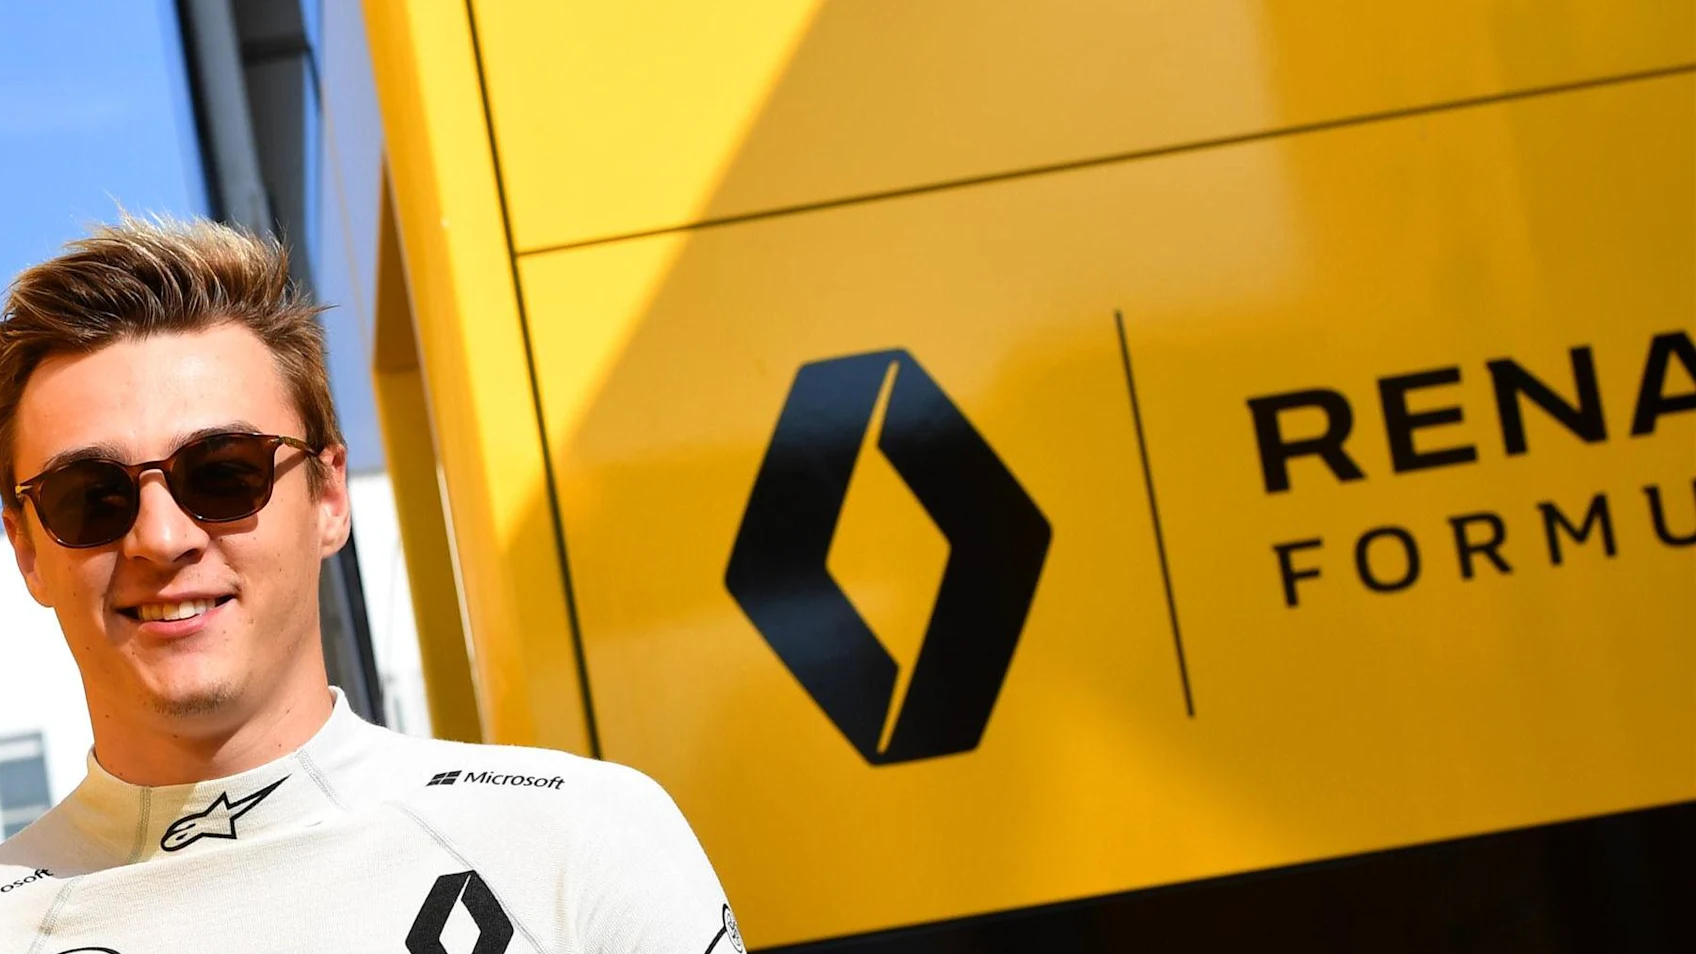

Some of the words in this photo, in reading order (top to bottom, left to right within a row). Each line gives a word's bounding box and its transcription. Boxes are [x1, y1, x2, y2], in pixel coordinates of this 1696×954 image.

[1245, 329, 1696, 495] RENA
[1272, 477, 1696, 608] FORMU
[464, 771, 565, 790] Microsoft
